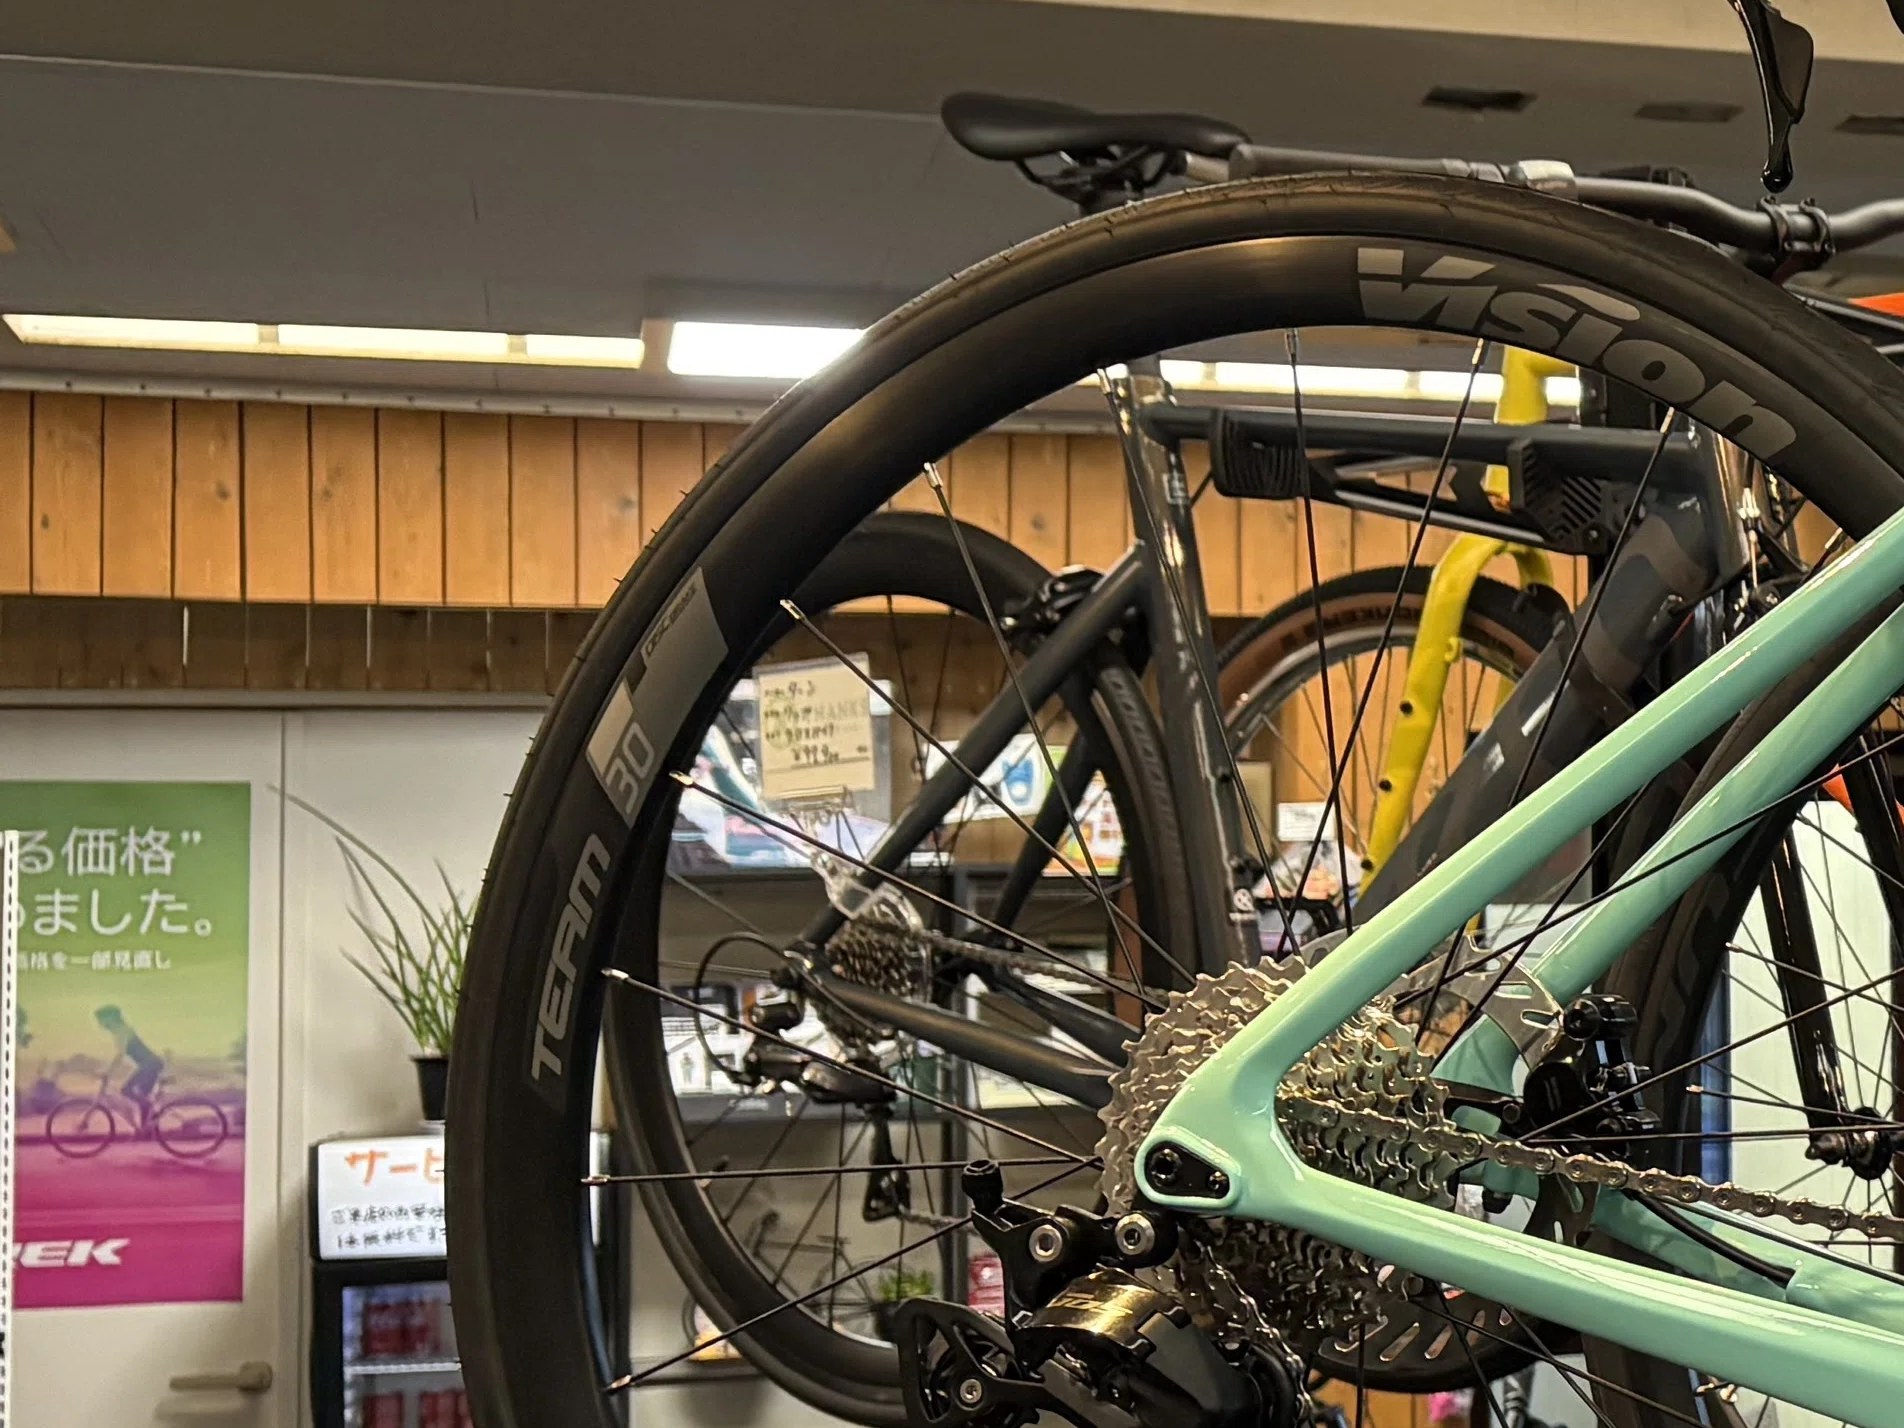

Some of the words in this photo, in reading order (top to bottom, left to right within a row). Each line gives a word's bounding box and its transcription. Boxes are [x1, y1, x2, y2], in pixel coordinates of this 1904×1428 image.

[603, 721, 656, 817] 30
[531, 832, 611, 1081] TEAM
[14, 1238, 131, 1269] EK
